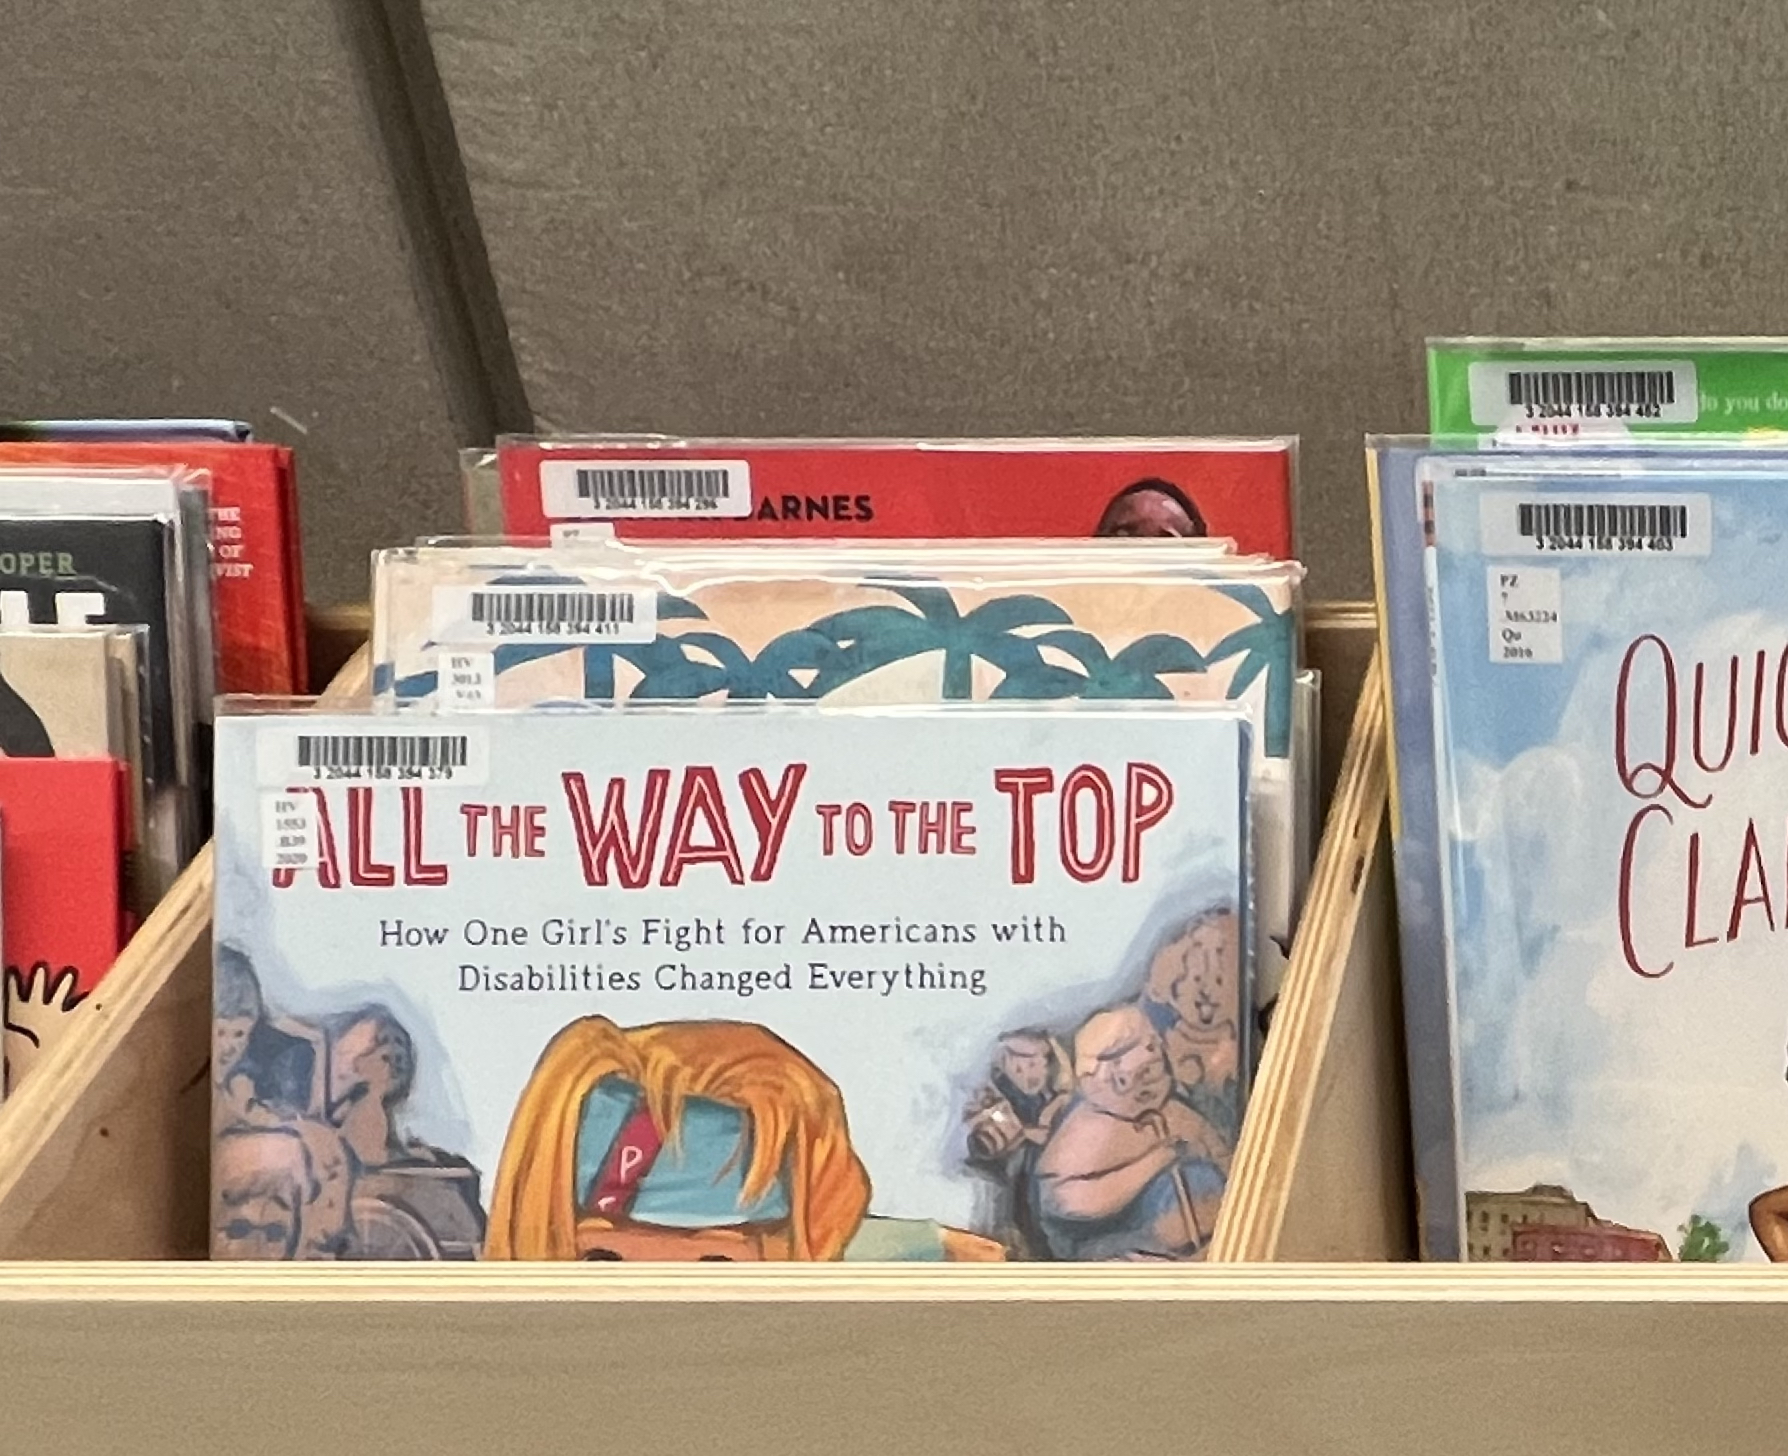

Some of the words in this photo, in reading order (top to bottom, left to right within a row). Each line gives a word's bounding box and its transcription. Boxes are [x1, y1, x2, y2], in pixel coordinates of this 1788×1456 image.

[1724, 396, 1759, 416] you
[1765, 392, 1788, 411] do
[736, 495, 874, 523] ARNES
[460, 803, 547, 858] THE
[561, 764, 807, 889] WAY
[815, 801, 874, 857] TO
[888, 800, 976, 855] THE
[994, 762, 1174, 885] TOP
[379, 919, 449, 947] How
[463, 919, 529, 947] One
[541, 918, 628, 947] Girl's
[642, 918, 725, 951] Fight
[742, 917, 786, 946] for
[802, 917, 977, 945] Americans
[992, 915, 1067, 944] with
[457, 964, 641, 992] Disabilities
[654, 963, 791, 997] Changed
[808, 962, 988, 997] Everything
